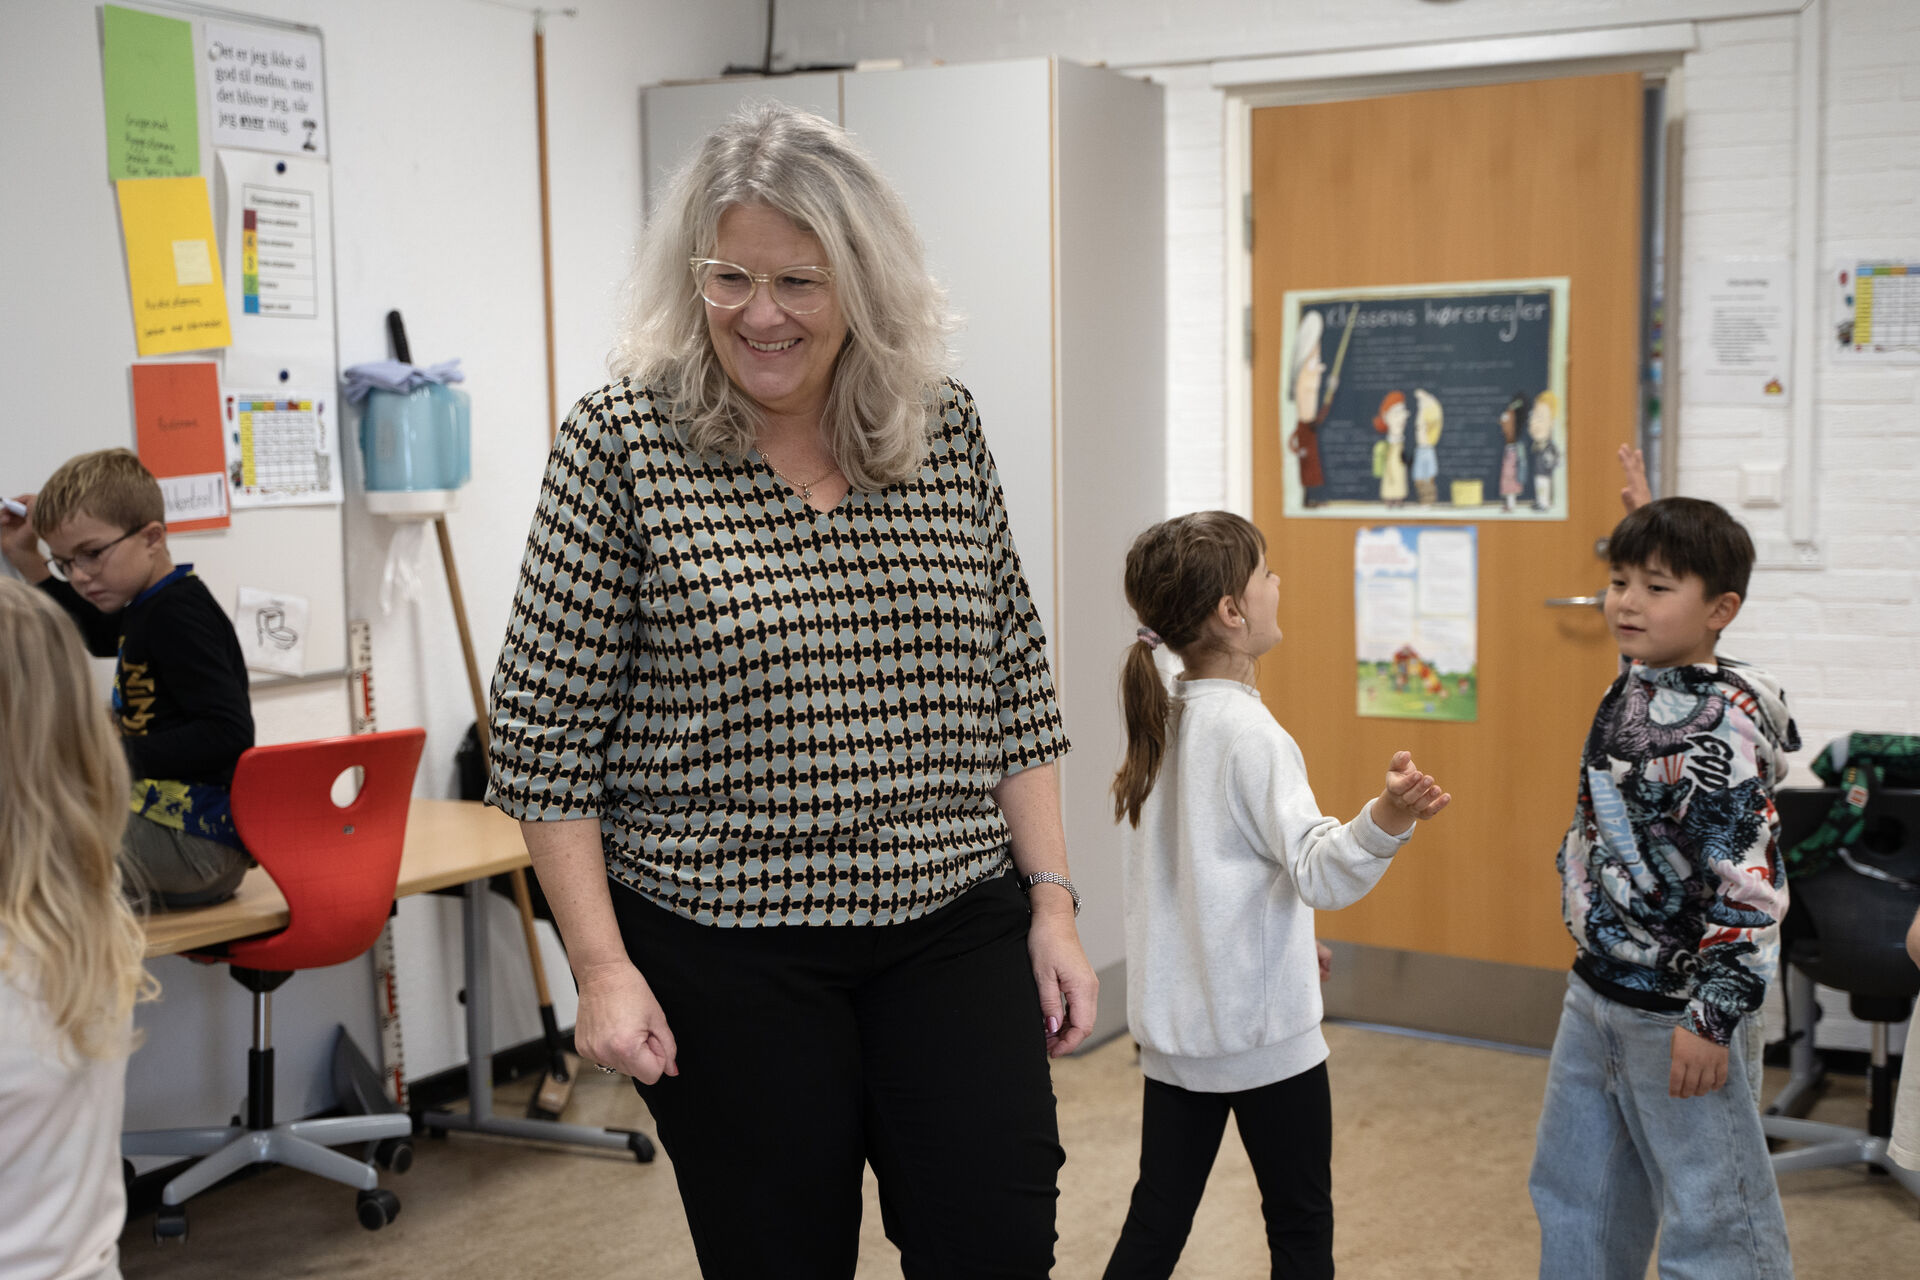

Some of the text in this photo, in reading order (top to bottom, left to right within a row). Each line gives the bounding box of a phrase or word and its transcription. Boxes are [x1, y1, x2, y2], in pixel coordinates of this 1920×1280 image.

[250, 47, 268, 68] jeg
[271, 49, 293, 68] ikke
[215, 66, 236, 84] god
[291, 79, 314, 93] men
[216, 87, 235, 104] det
[236, 88, 269, 107] bliver
[218, 109, 238, 129] jeg
[1424, 296, 1546, 342] høreregler
